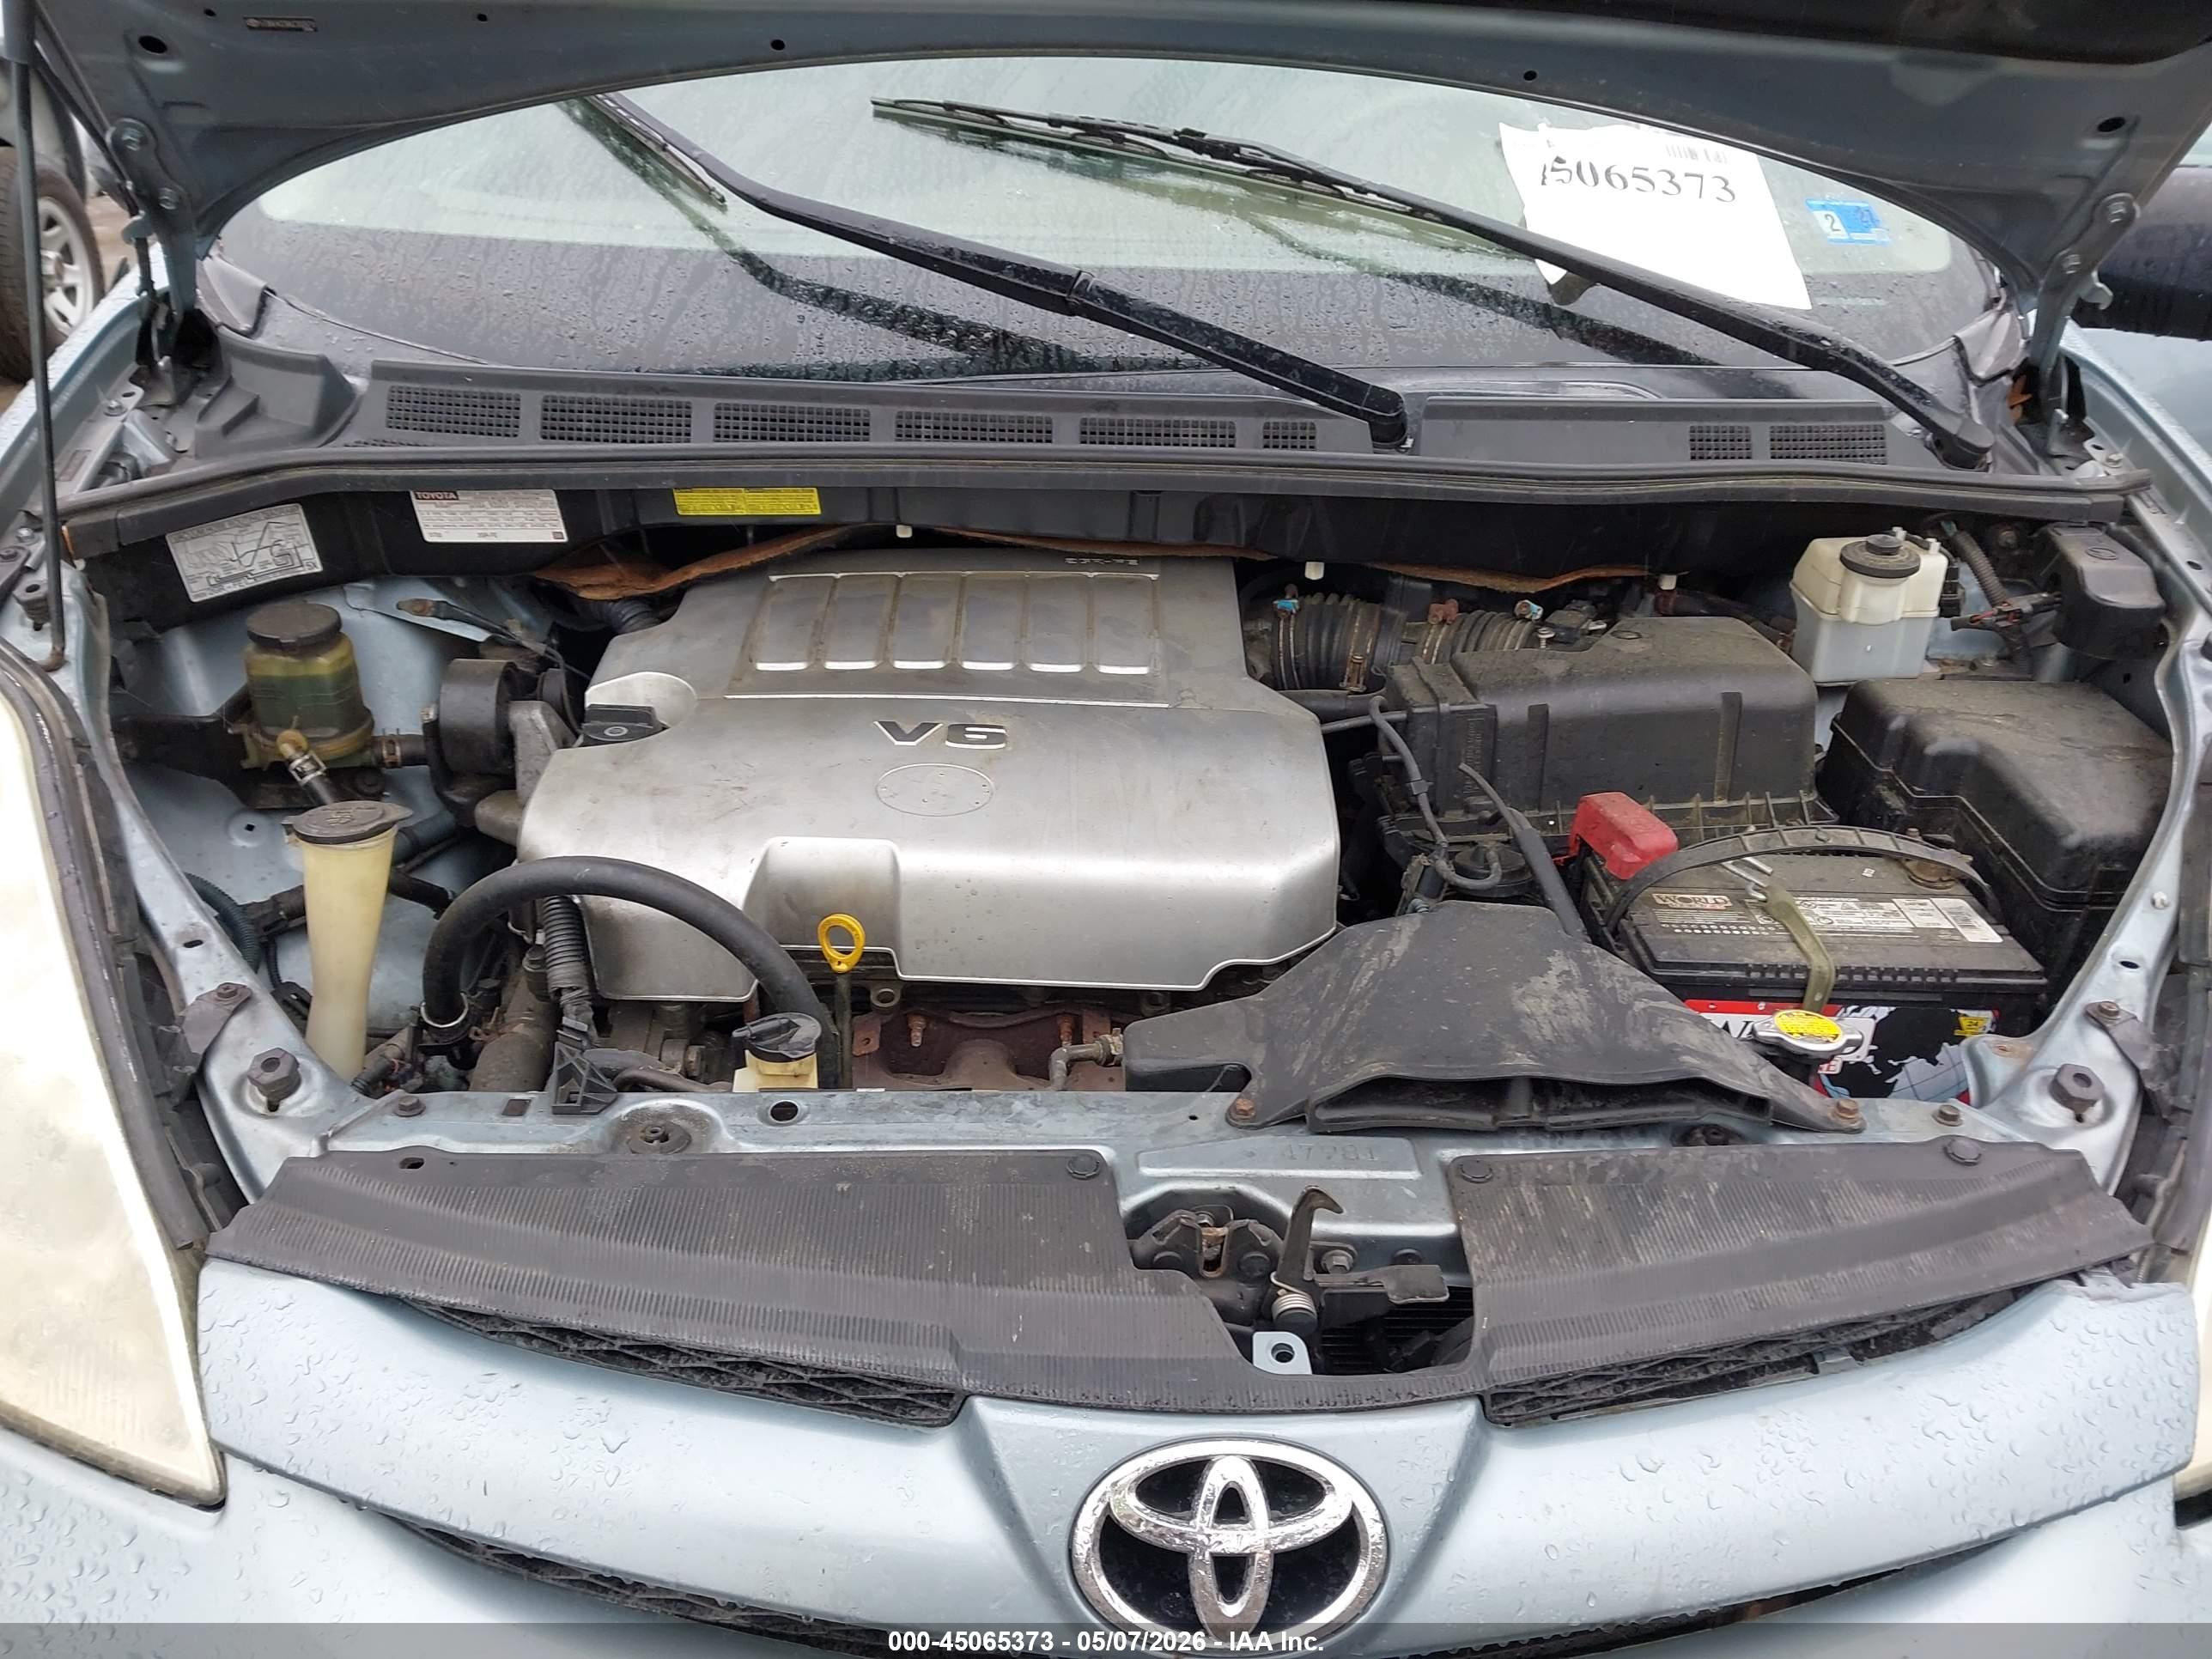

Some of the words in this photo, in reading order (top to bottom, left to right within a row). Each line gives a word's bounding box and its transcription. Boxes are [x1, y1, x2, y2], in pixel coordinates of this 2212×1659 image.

[1825, 214, 1841, 231] 2
[416, 491, 457, 500] TOYOTA
[873, 720, 1006, 749] V6
[1656, 894, 1729, 906] WORLD
